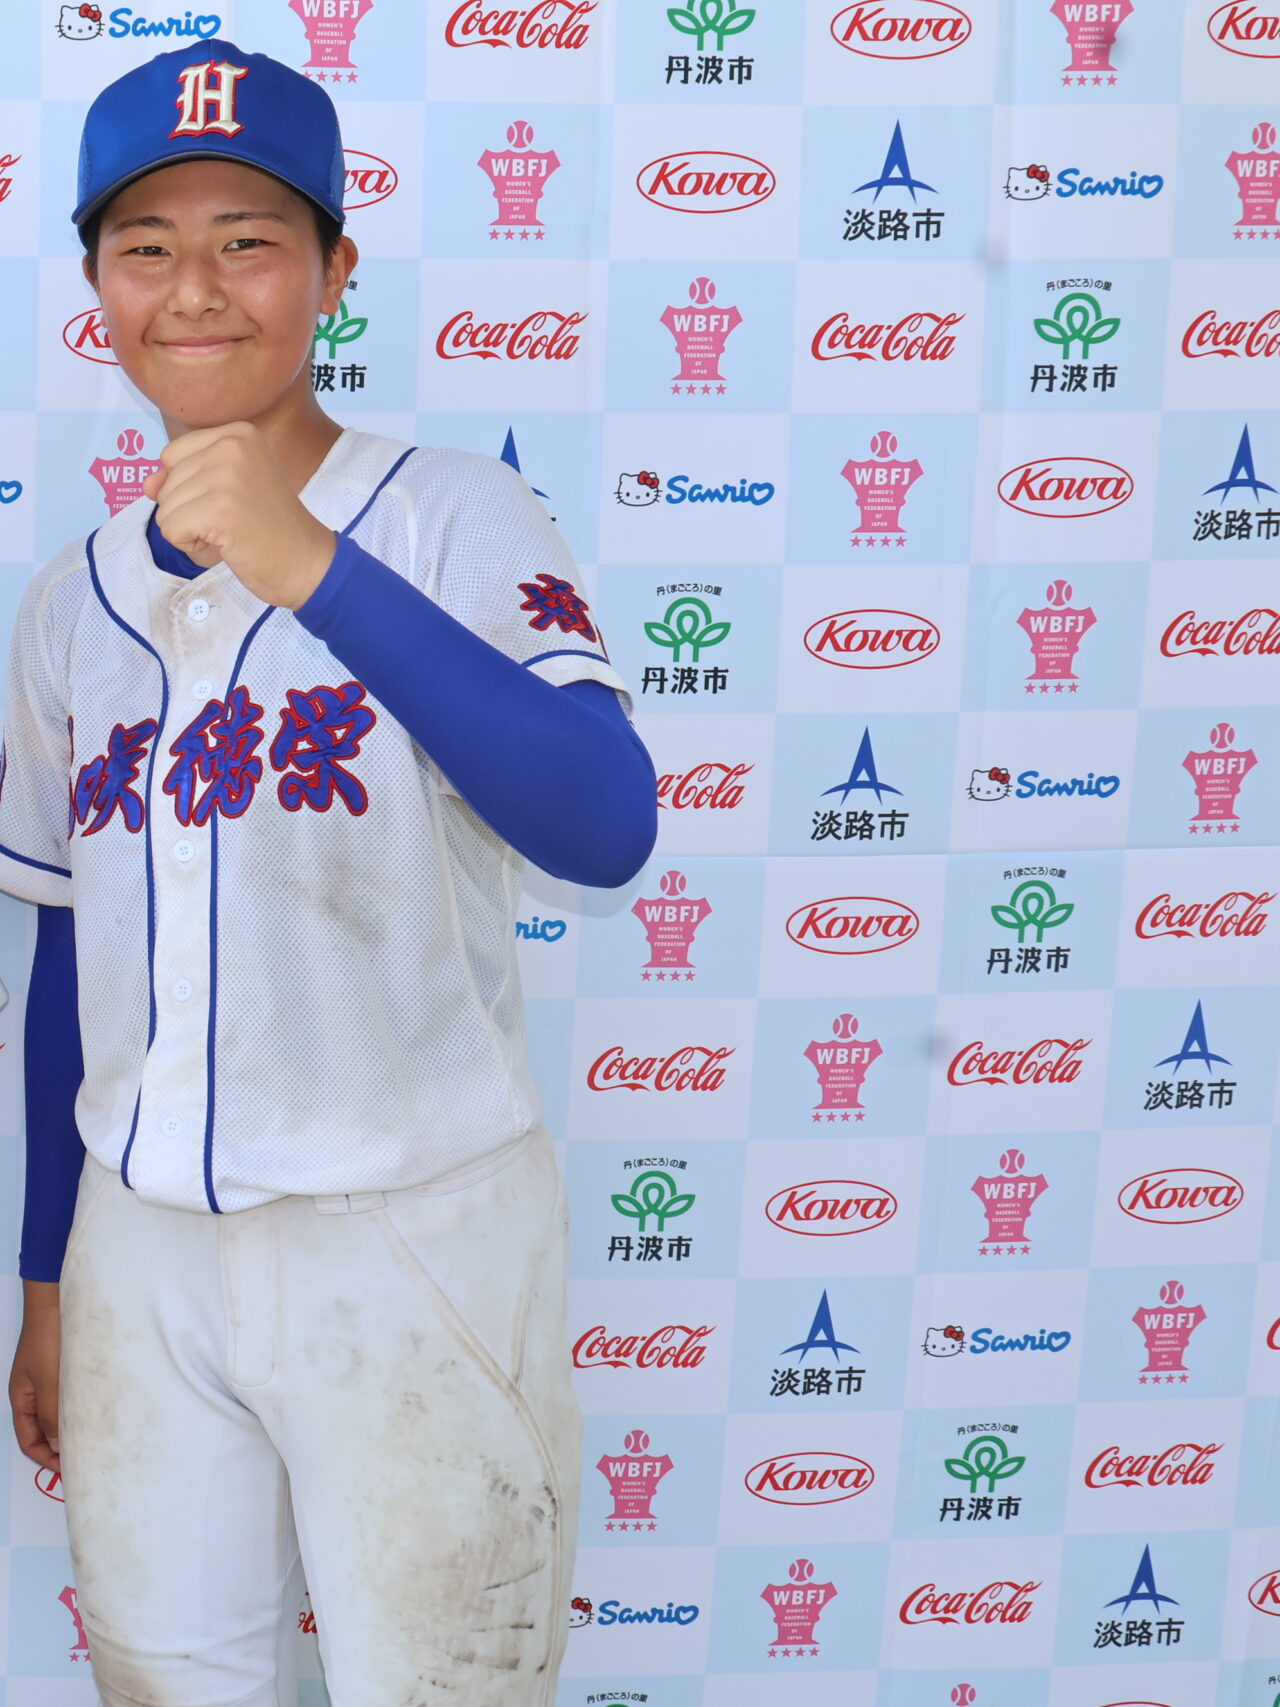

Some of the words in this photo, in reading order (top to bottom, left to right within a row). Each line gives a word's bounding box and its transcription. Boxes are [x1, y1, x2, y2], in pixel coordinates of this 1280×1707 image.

[108, 7, 221, 39] Sanrio
[303, 0, 359, 18] WBFJ
[445, 0, 596, 48] Coca-Cola
[1063, 4, 1121, 22] WBFJ
[1217, 6, 1280, 40] Ko
[842, 7, 967, 42] Kowa
[666, 56, 754, 84] 丹波市
[168, 60, 250, 139] H
[492, 158, 548, 176] WBFJ
[648, 162, 770, 195] Kowa
[1237, 159, 1280, 178] WBF
[1056, 168, 1164, 199] Sanrio
[843, 209, 944, 241] 淡路市
[436, 311, 586, 360] Coca-Cola
[674, 314, 730, 332] WBFJ
[812, 312, 963, 360] Coca-Cola
[312, 363, 367, 391] 波市
[1031, 364, 1117, 392] 丹波市
[665, 475, 775, 506] Sanrio
[854, 468, 911, 485] WBFJ
[1009, 468, 1129, 500] Kowa
[814, 620, 935, 652] Kowa
[1030, 616, 1085, 632] WBFJ
[642, 667, 729, 694] 丹波市
[67, 681, 377, 841] 咲徳栄
[1195, 758, 1247, 775] WBFJ
[1015, 771, 1120, 798] Sanrio
[811, 810, 909, 840] 淡路市
[644, 906, 700, 922] WBFJ
[796, 907, 913, 939] Kowa
[1136, 892, 1275, 939] Coca-Cola
[987, 947, 1070, 974] 丹波市
[587, 1047, 735, 1091] Coca-Cola
[817, 1048, 870, 1064] WBFJ
[947, 1039, 1088, 1086] Coca-Cola
[1144, 1079, 1236, 1110] 淡路市
[775, 1190, 892, 1222] Kowa
[984, 1182, 1037, 1200] WBFJ
[1126, 1179, 1238, 1210] Kowa
[608, 1236, 692, 1261] 丹波市
[1144, 1313, 1195, 1329] WBFJ
[572, 1325, 712, 1368] Coca-Cola
[970, 1328, 1072, 1354] Sanrio
[770, 1367, 865, 1396] 淡路市
[609, 1462, 663, 1478] WBFJ
[754, 1462, 869, 1492] Kowa
[1085, 1444, 1220, 1488] Coca-Cola
[940, 1496, 1021, 1521] 丹波市
[774, 1590, 826, 1605] WBFJ
[899, 1582, 1038, 1624] Coca-Cola
[597, 1601, 698, 1626] Sanrio
[1094, 1618, 1184, 1648] 淡路市
